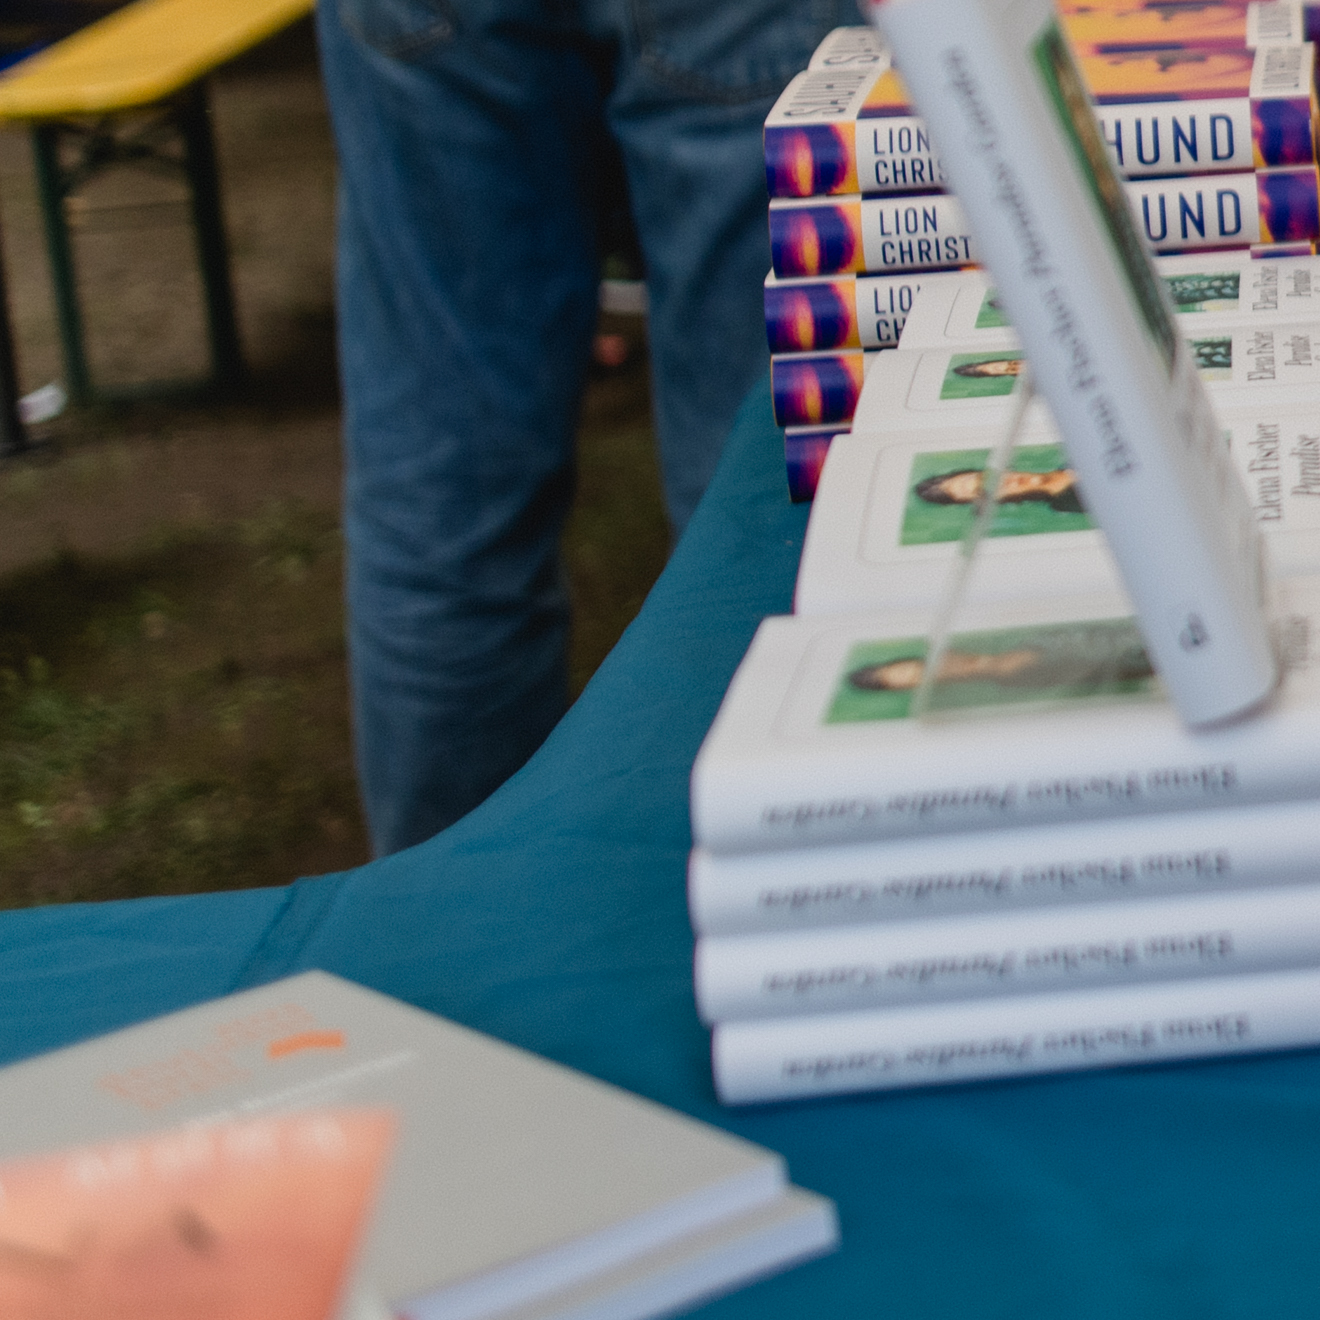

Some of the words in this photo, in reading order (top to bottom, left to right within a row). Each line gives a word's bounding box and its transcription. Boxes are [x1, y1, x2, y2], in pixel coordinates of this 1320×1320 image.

[874, 127, 930, 155] LION
[880, 206, 938, 236] LION
[881, 236, 971, 265] CHRIST
[874, 284, 920, 314] LIO
[1248, 423, 1279, 473] Fischer
[1253, 477, 1281, 521] Elena
